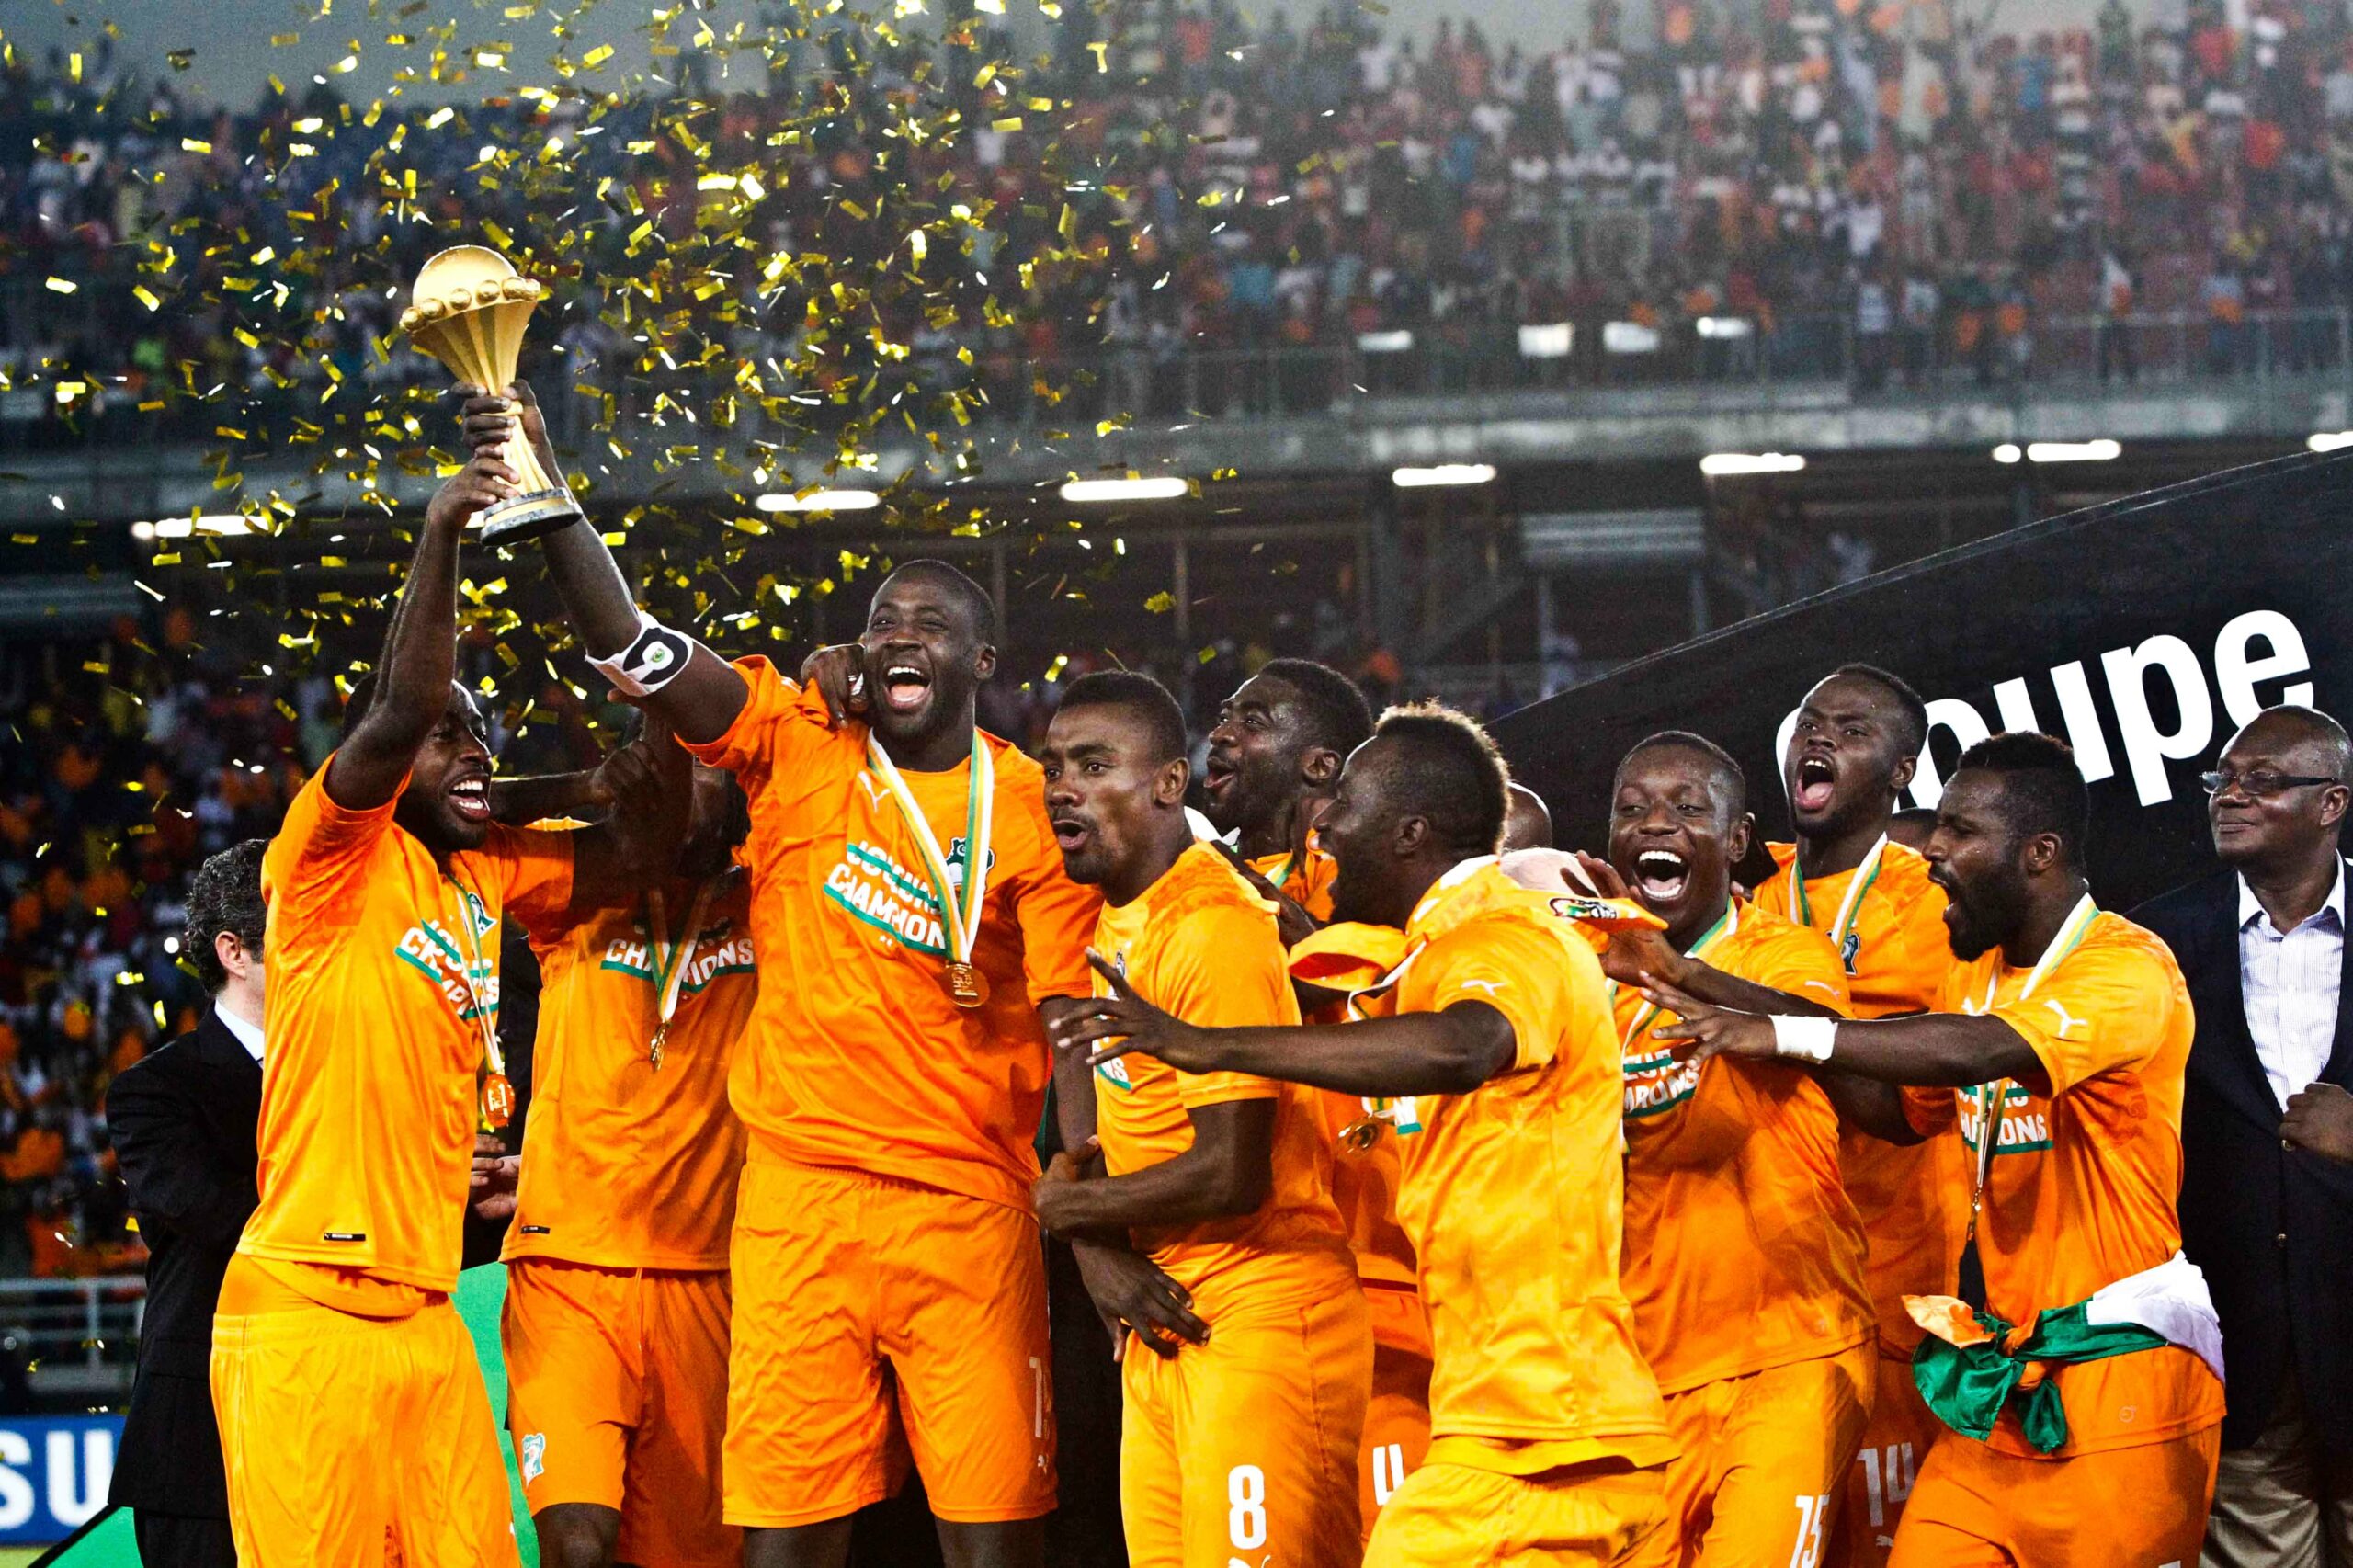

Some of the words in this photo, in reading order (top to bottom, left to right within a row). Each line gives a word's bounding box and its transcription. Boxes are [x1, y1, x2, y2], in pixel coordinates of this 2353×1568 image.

[1775, 610, 2314, 814] oupe
[828, 863, 946, 949] CHAMPION
[1228, 1464, 1267, 1551] 8
[1857, 1441, 1915, 1528] 14
